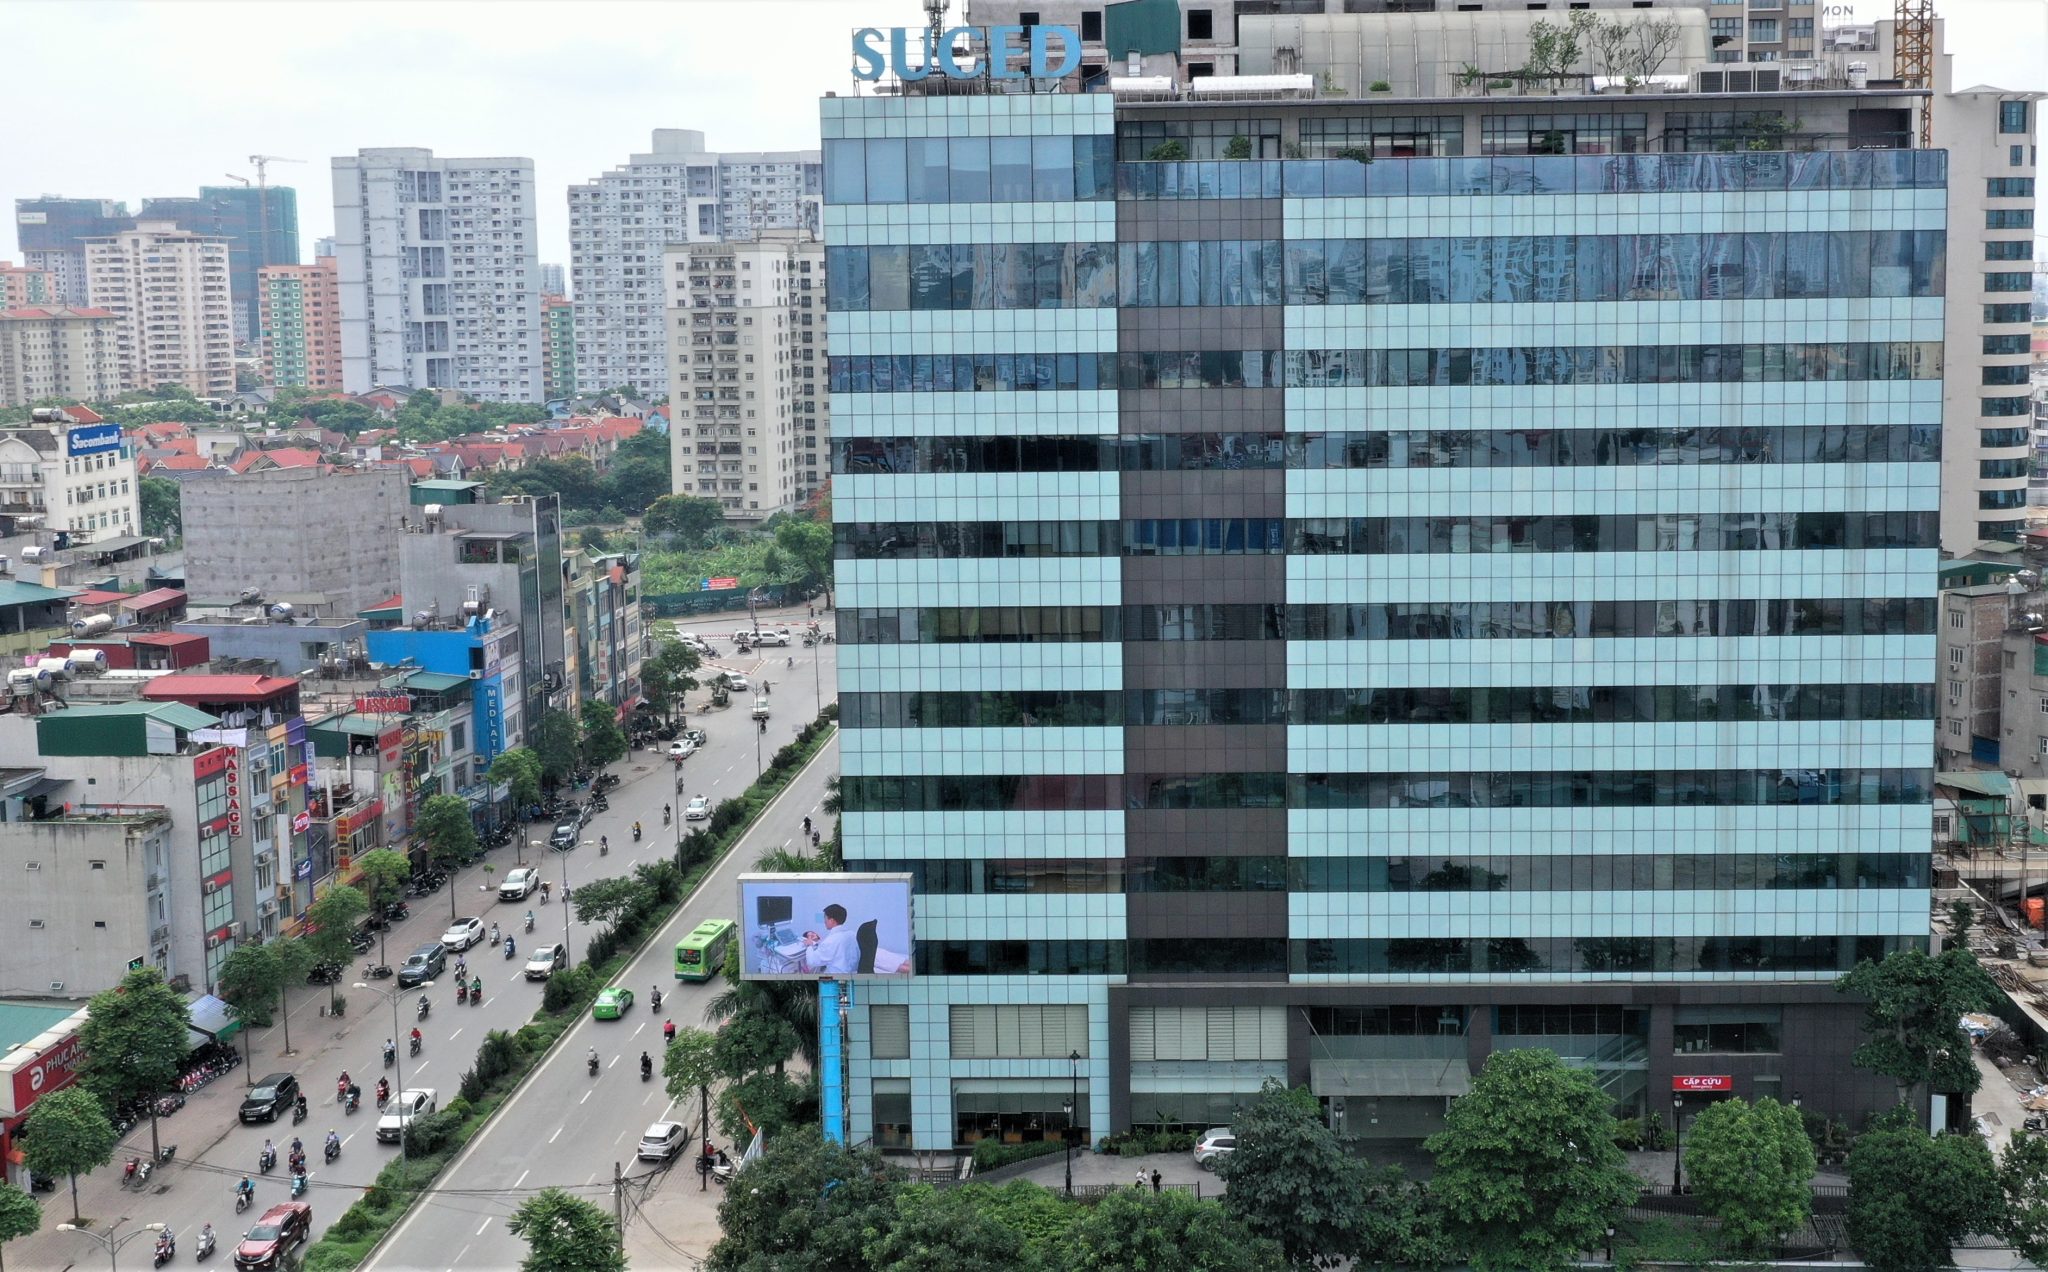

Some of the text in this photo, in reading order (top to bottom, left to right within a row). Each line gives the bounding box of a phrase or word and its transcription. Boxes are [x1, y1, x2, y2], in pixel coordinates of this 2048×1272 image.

[851, 26, 1081, 81] SUCED
[71, 430, 119, 450] Sacombank
[487, 689, 498, 764] MEDLATE
[224, 746, 240, 836] MASSAGE
[1683, 1077, 1721, 1085] CẤP CỨU
